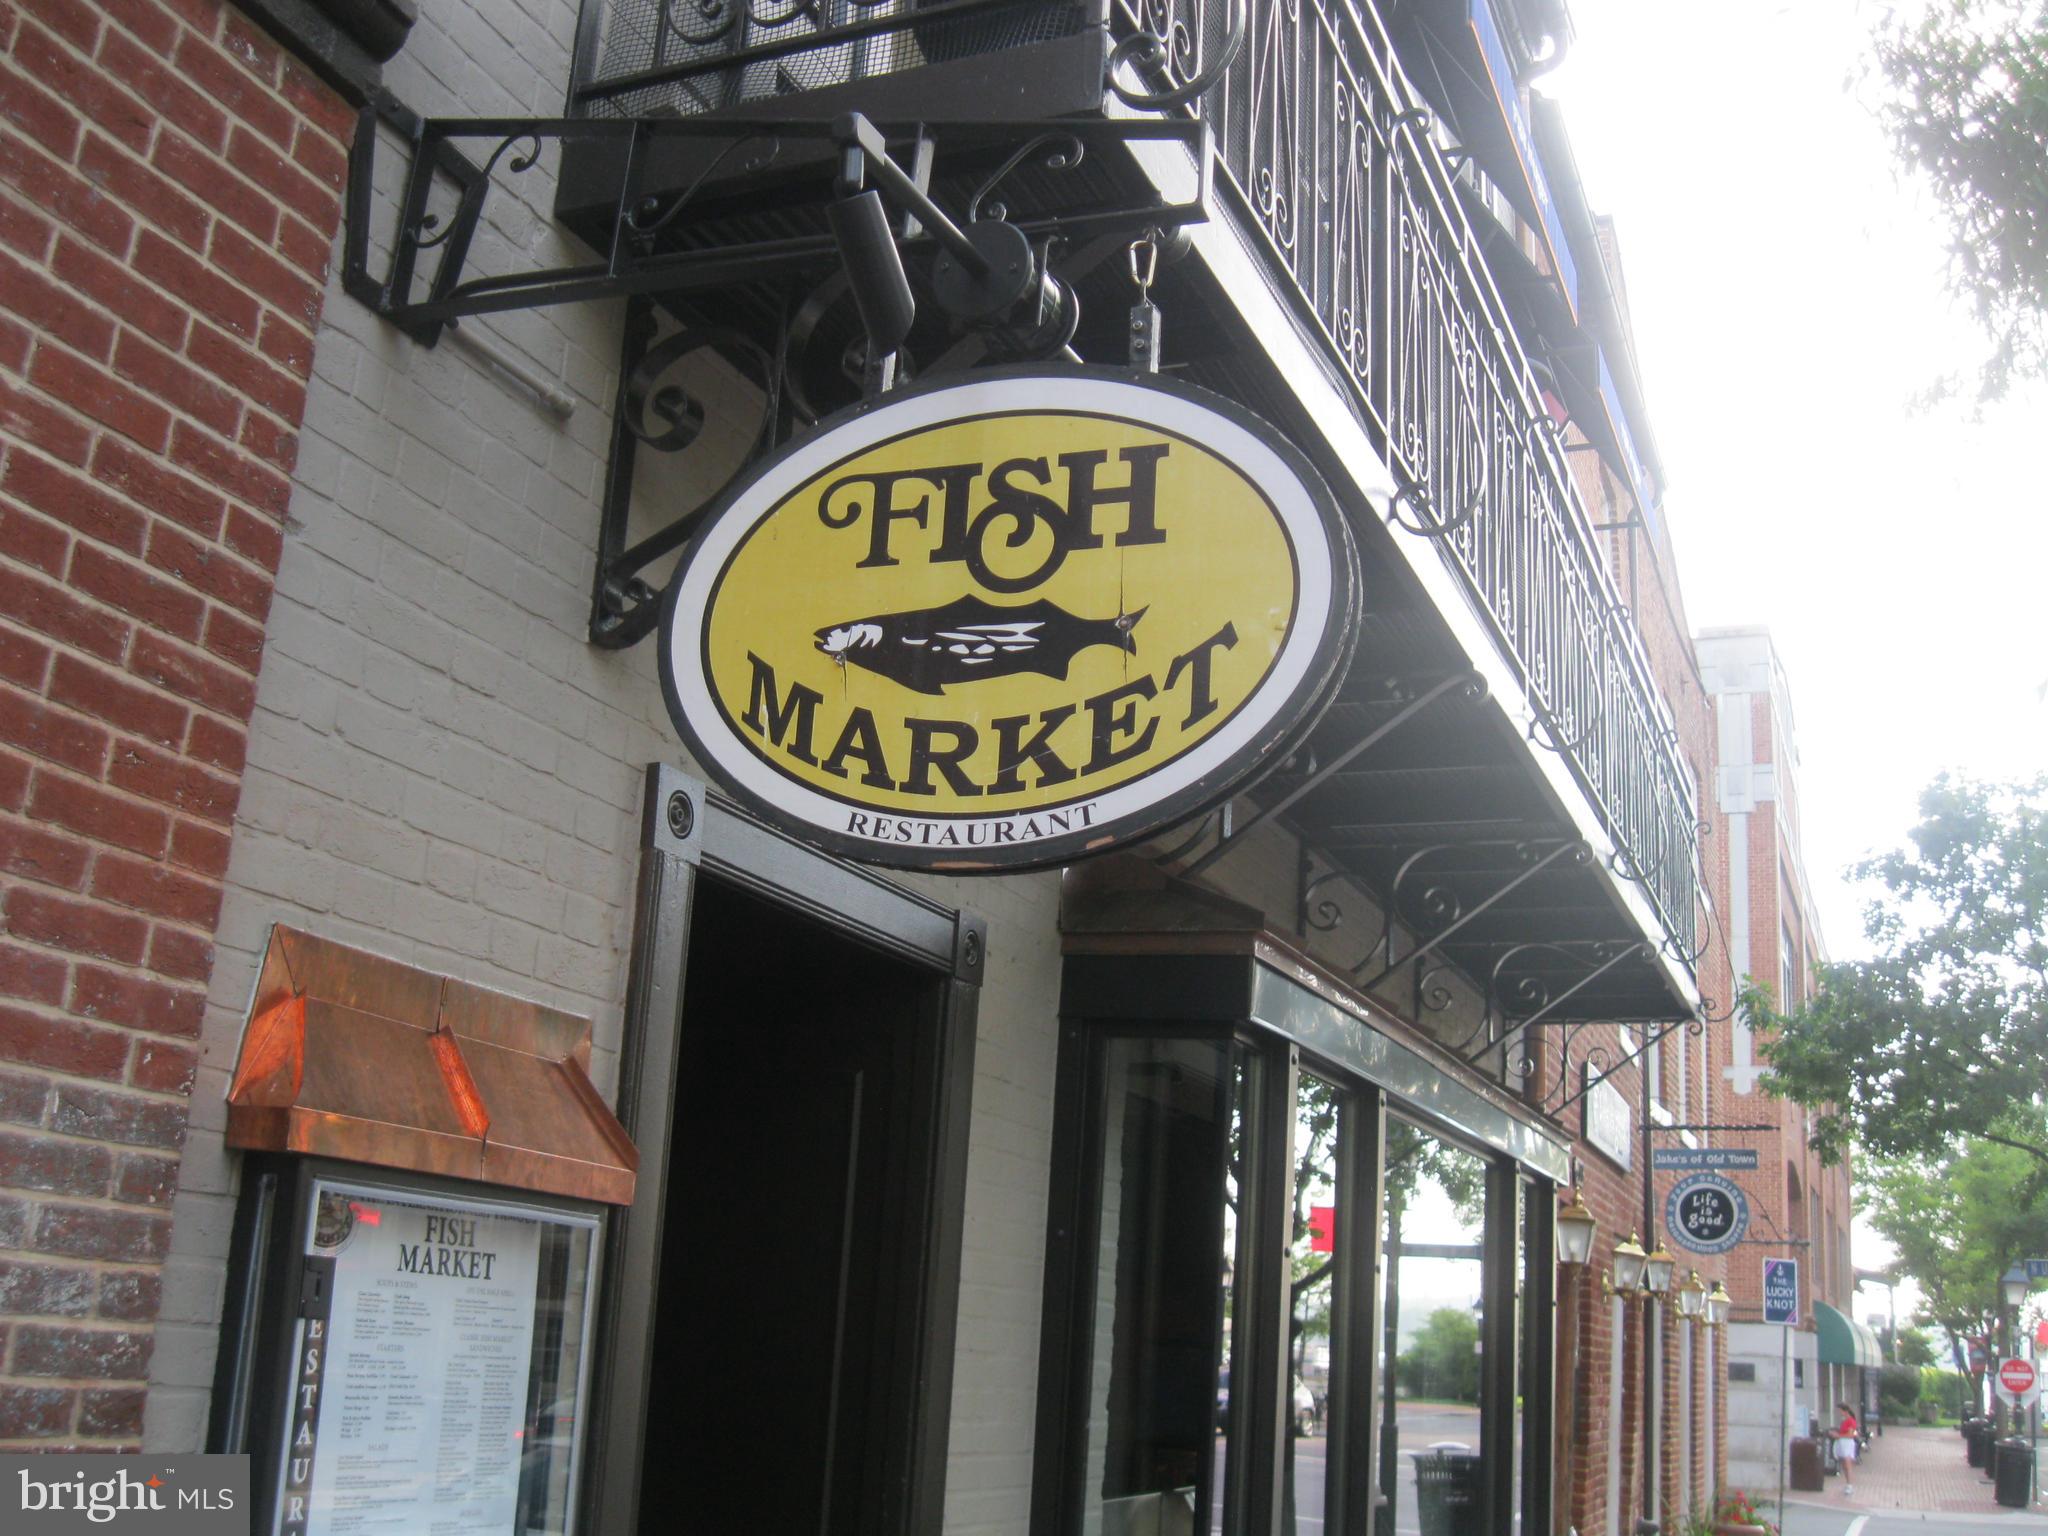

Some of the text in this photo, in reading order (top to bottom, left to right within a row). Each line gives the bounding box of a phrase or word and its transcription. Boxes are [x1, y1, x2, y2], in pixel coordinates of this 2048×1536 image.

[817, 444, 1171, 594] FISH
[742, 621, 1239, 797] MARKET
[846, 803, 1098, 846] RESTAURANT
[1655, 1153, 1755, 1164] Jake's of Old Town
[1692, 1192, 1719, 1207] Life
[1700, 1206, 1713, 1216] is
[425, 1214, 477, 1248] FISH
[397, 1244, 496, 1281] MARKET
[1766, 1286, 1794, 1298] LUCKY
[1766, 1298, 1795, 1310] KNOT
[287, 1319, 325, 1536] ESTAUR
